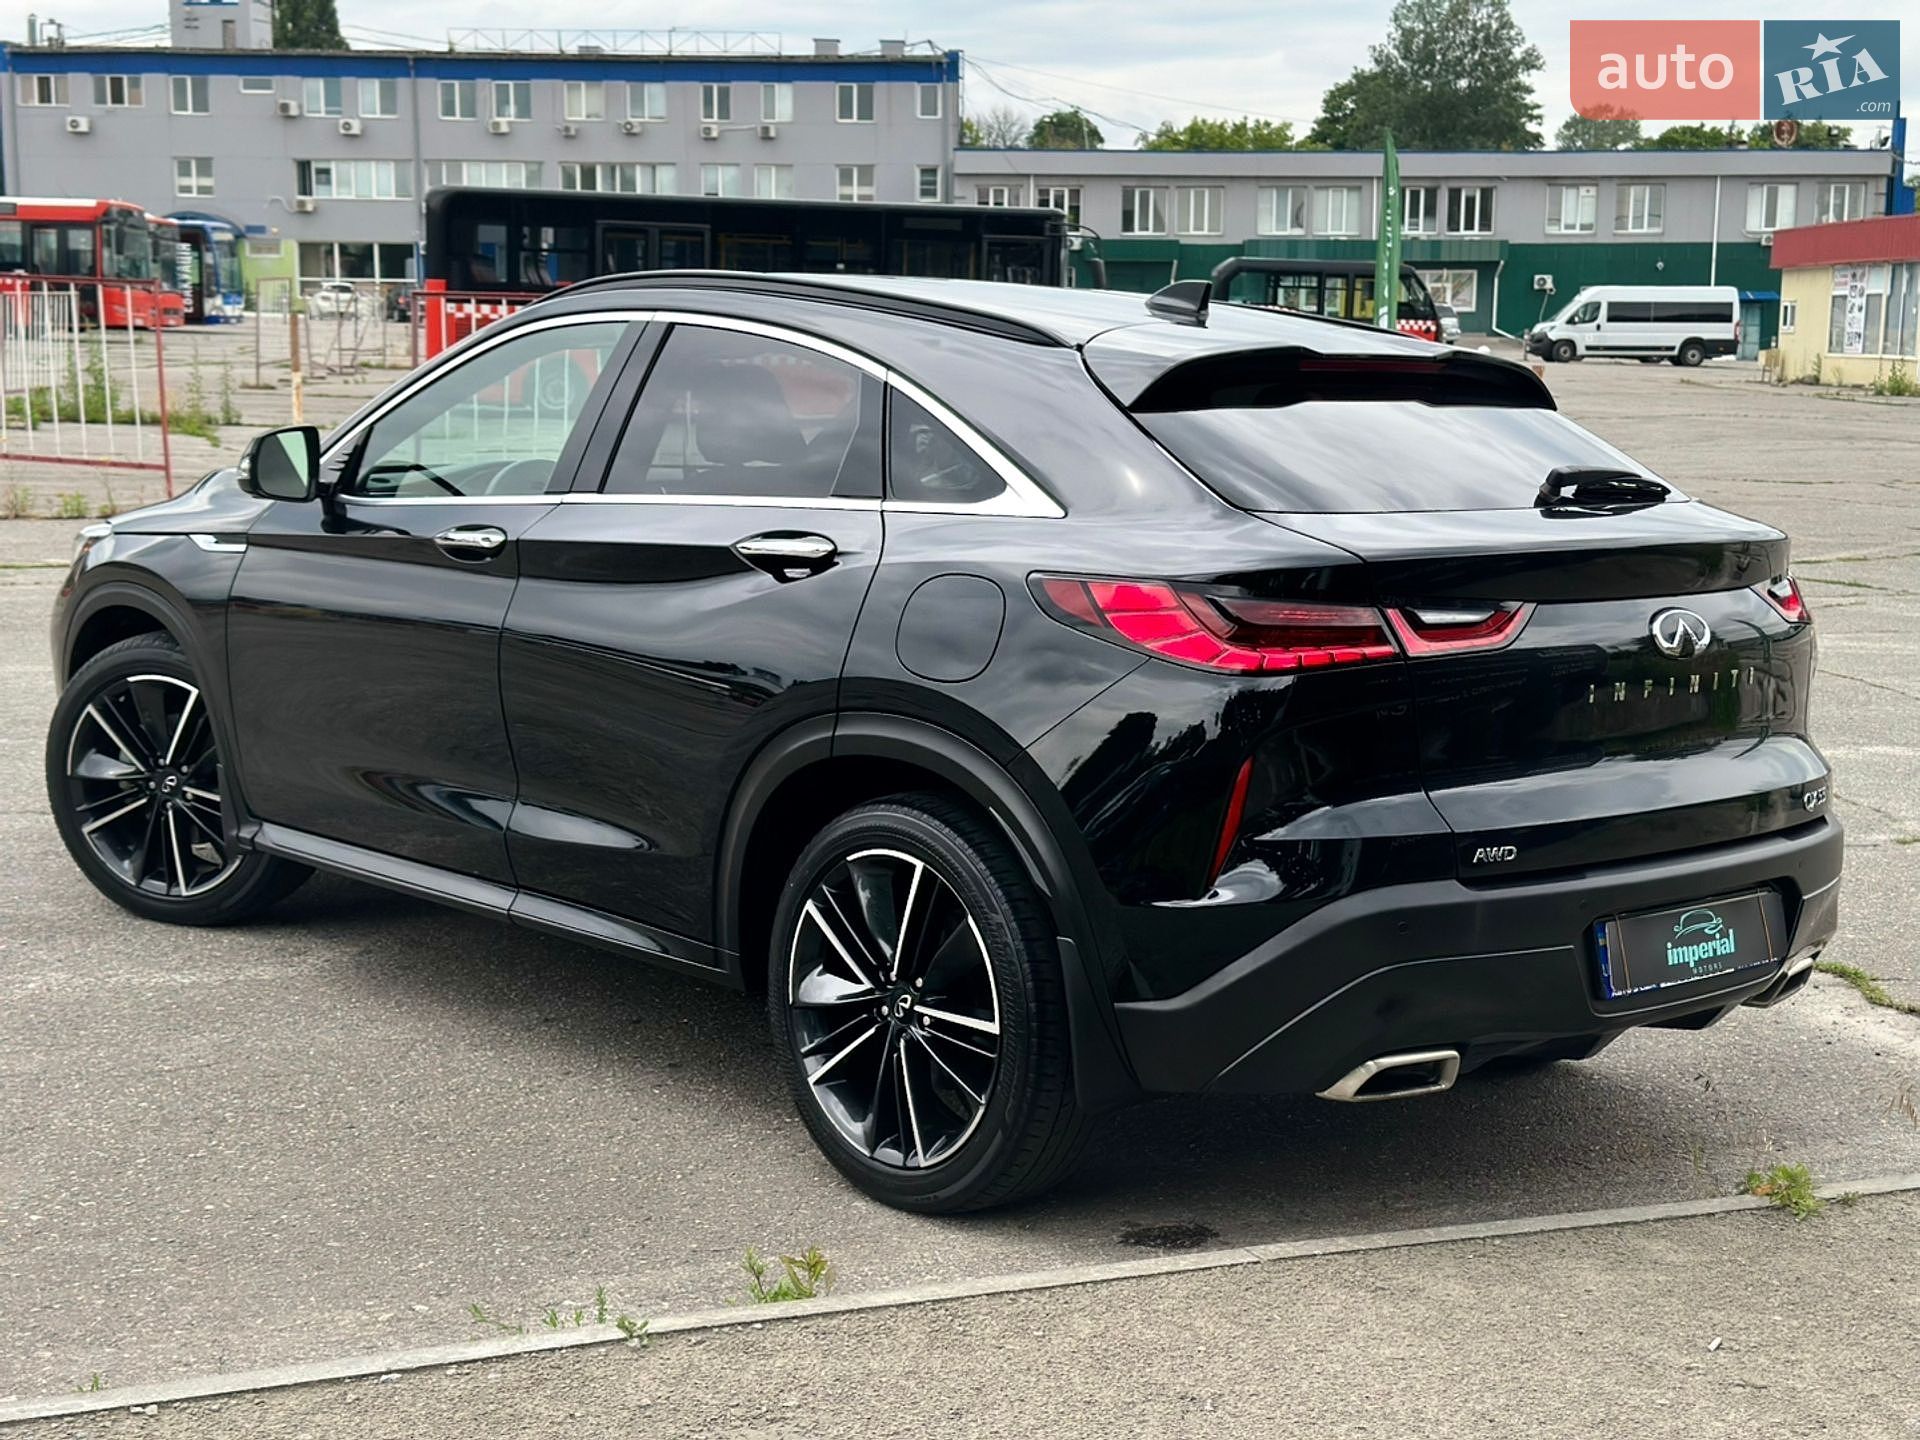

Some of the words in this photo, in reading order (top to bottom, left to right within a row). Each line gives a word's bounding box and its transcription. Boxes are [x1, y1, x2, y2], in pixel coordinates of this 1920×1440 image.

[1588, 666, 1755, 704] INFINITI
[1472, 845, 1518, 863] AWD
[1666, 928, 1736, 967] imperial
[1692, 961, 1723, 975] MOTORS
